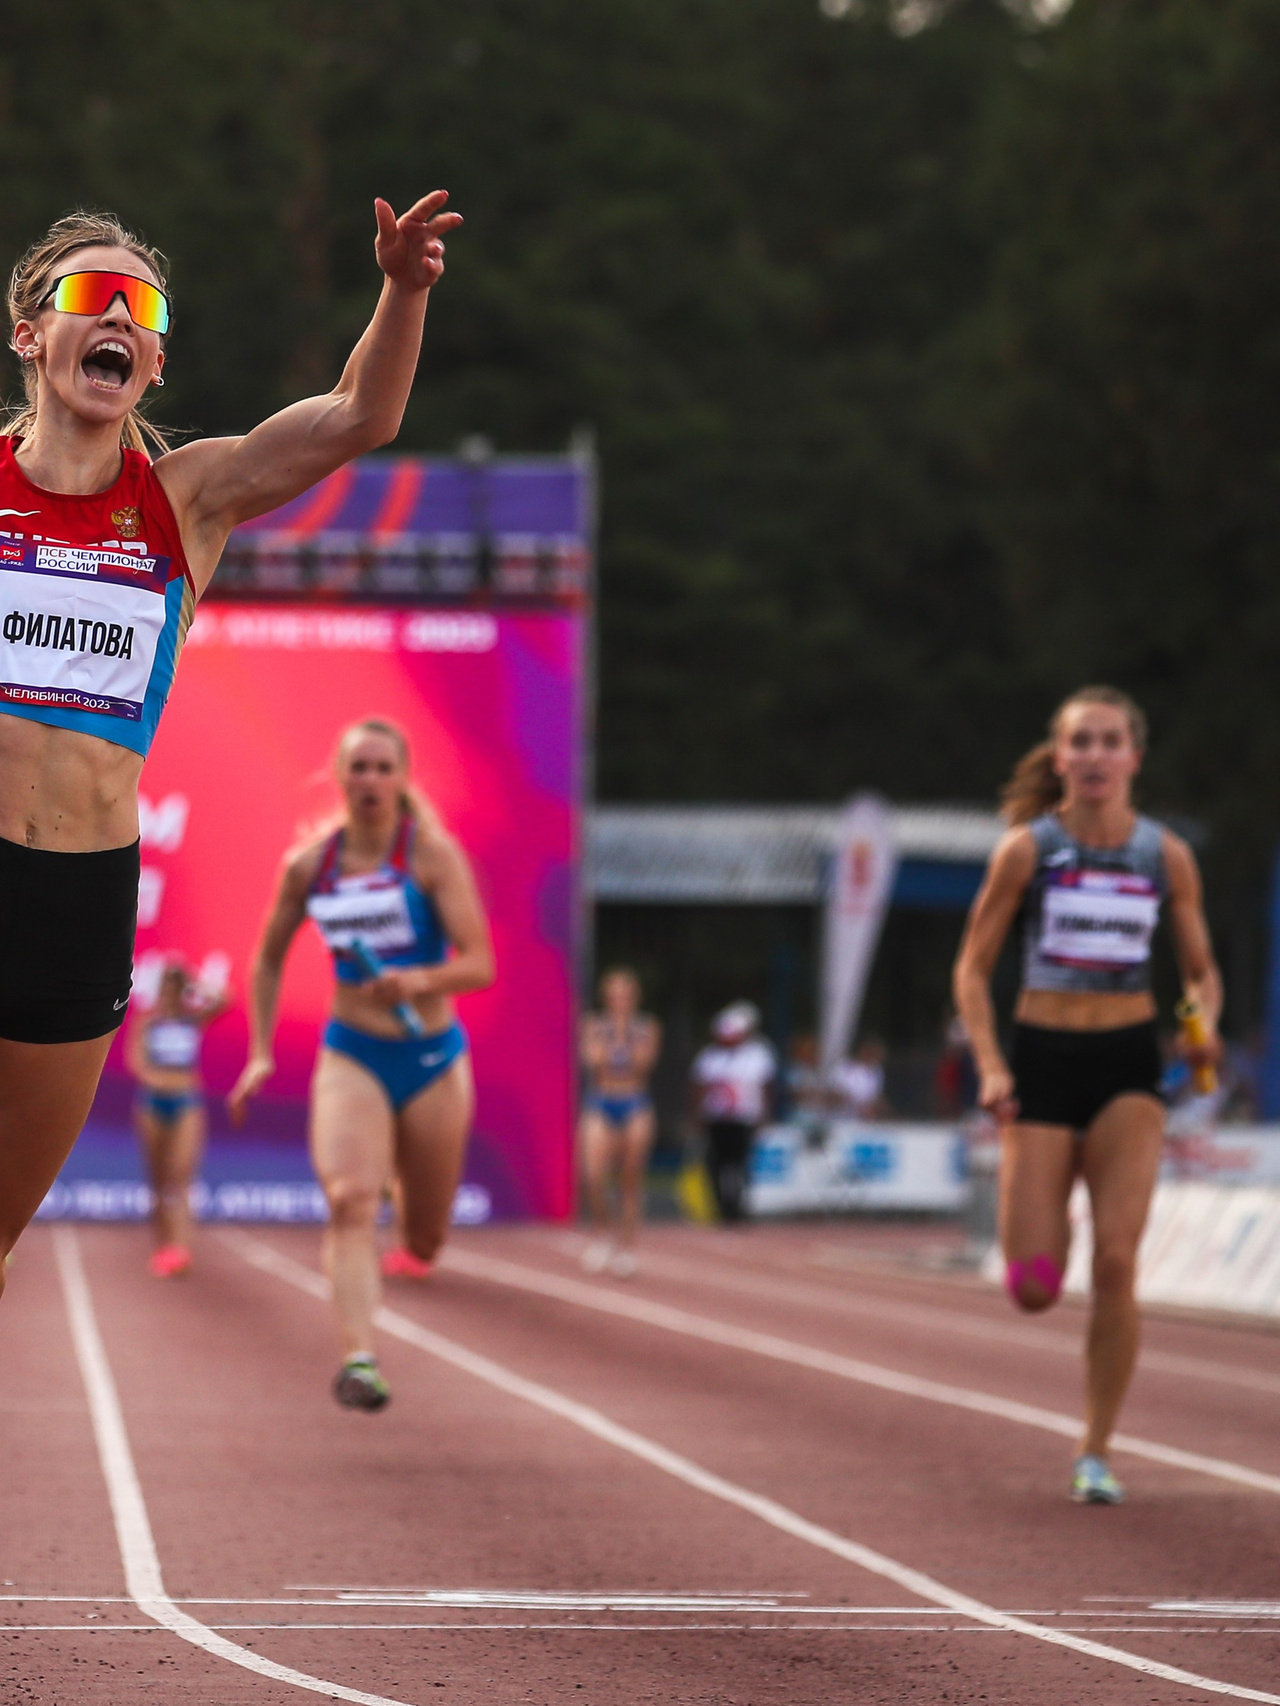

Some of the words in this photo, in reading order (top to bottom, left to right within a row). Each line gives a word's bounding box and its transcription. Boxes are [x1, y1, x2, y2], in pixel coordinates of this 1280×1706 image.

[38, 558, 96, 572] РОССИИ
[39, 547, 67, 558] ПСБ
[71, 550, 155, 570] ЧЕМПИОНАТ
[2, 610, 134, 660] ФИЛАТОВА
[4, 688, 81, 704] ЧЕЛЯБИНСК
[82, 697, 111, 710] 2023
